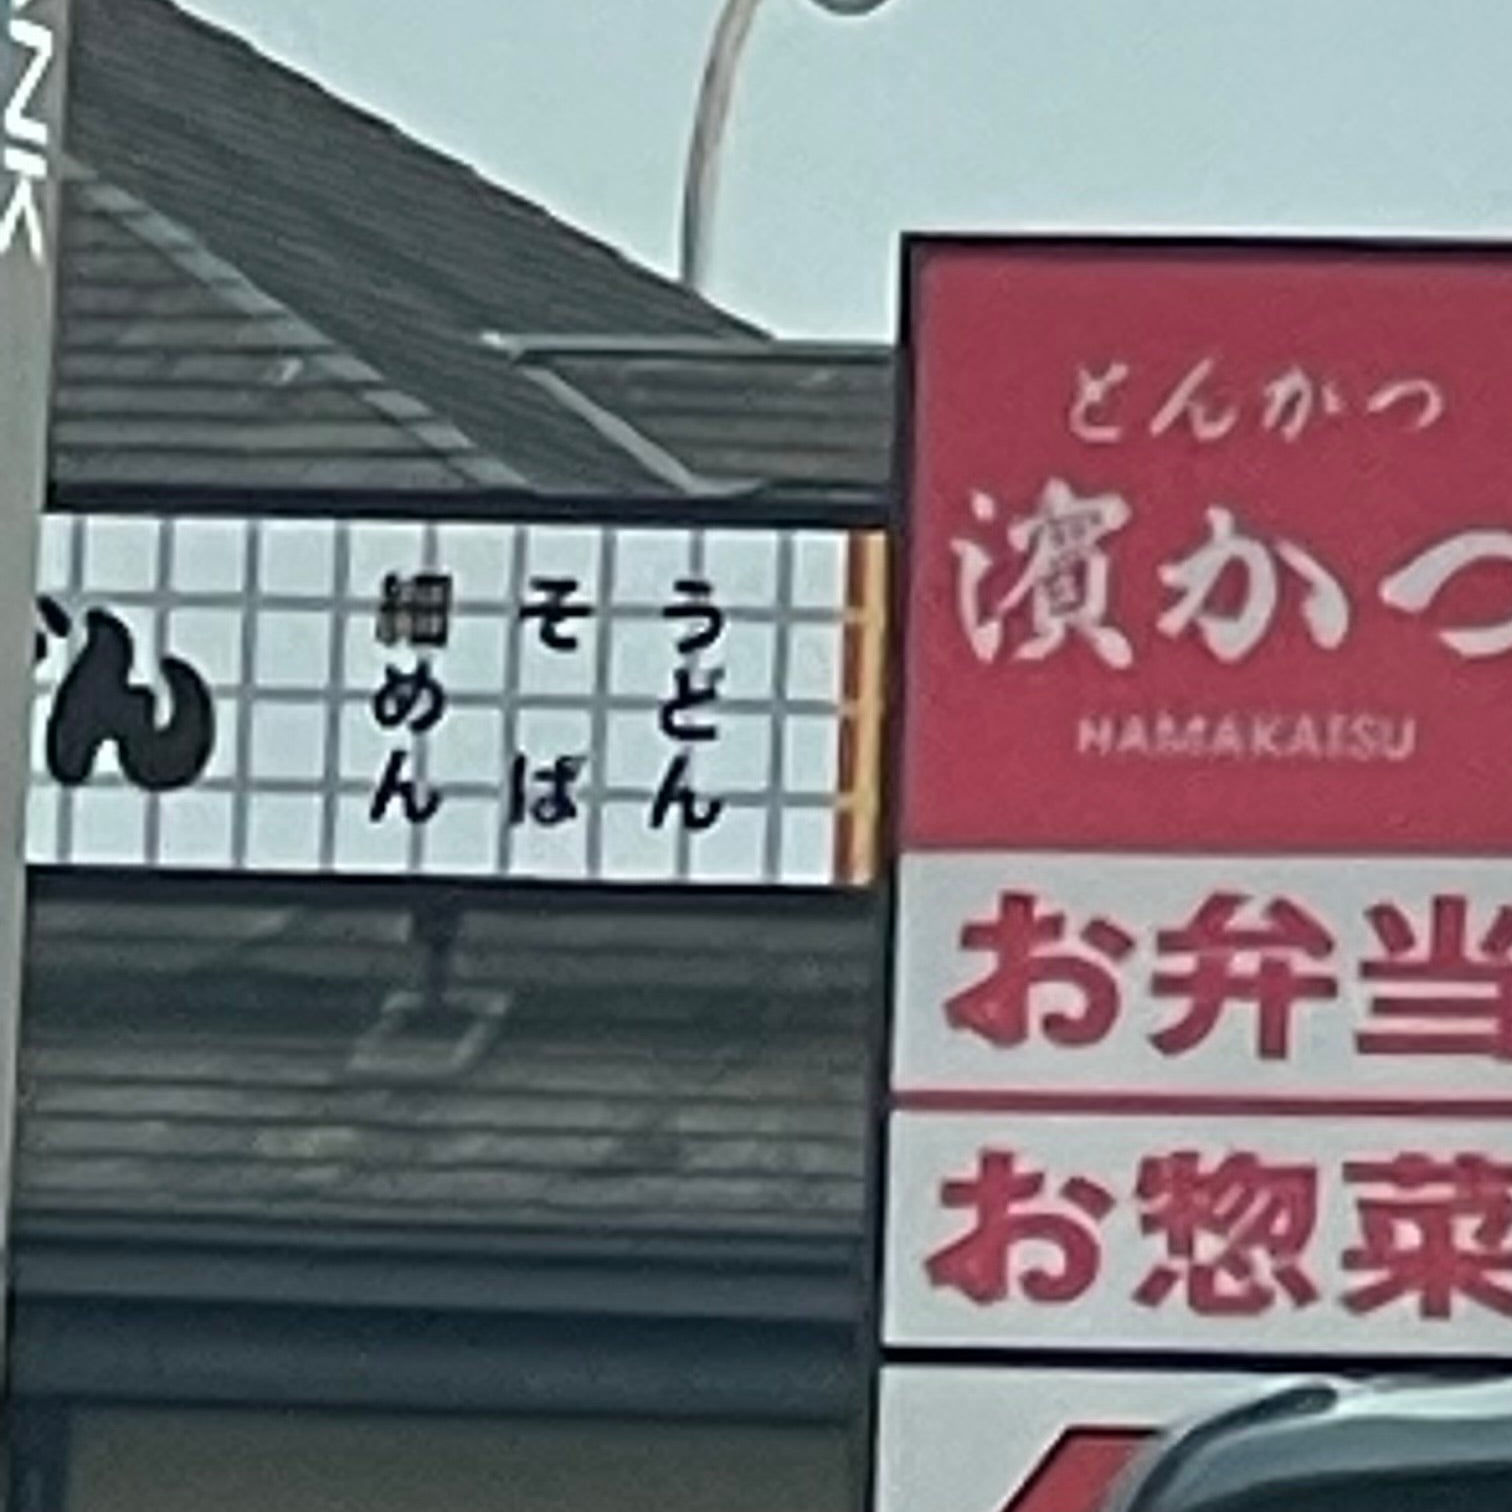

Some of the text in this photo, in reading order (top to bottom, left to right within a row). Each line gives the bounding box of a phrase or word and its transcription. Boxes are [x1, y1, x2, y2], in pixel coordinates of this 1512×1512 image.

[1069, 358, 1444, 442] とんかつ
[370, 574, 451, 825] 細めん
[508, 578, 594, 826] そば
[651, 578, 725, 831] うどん
